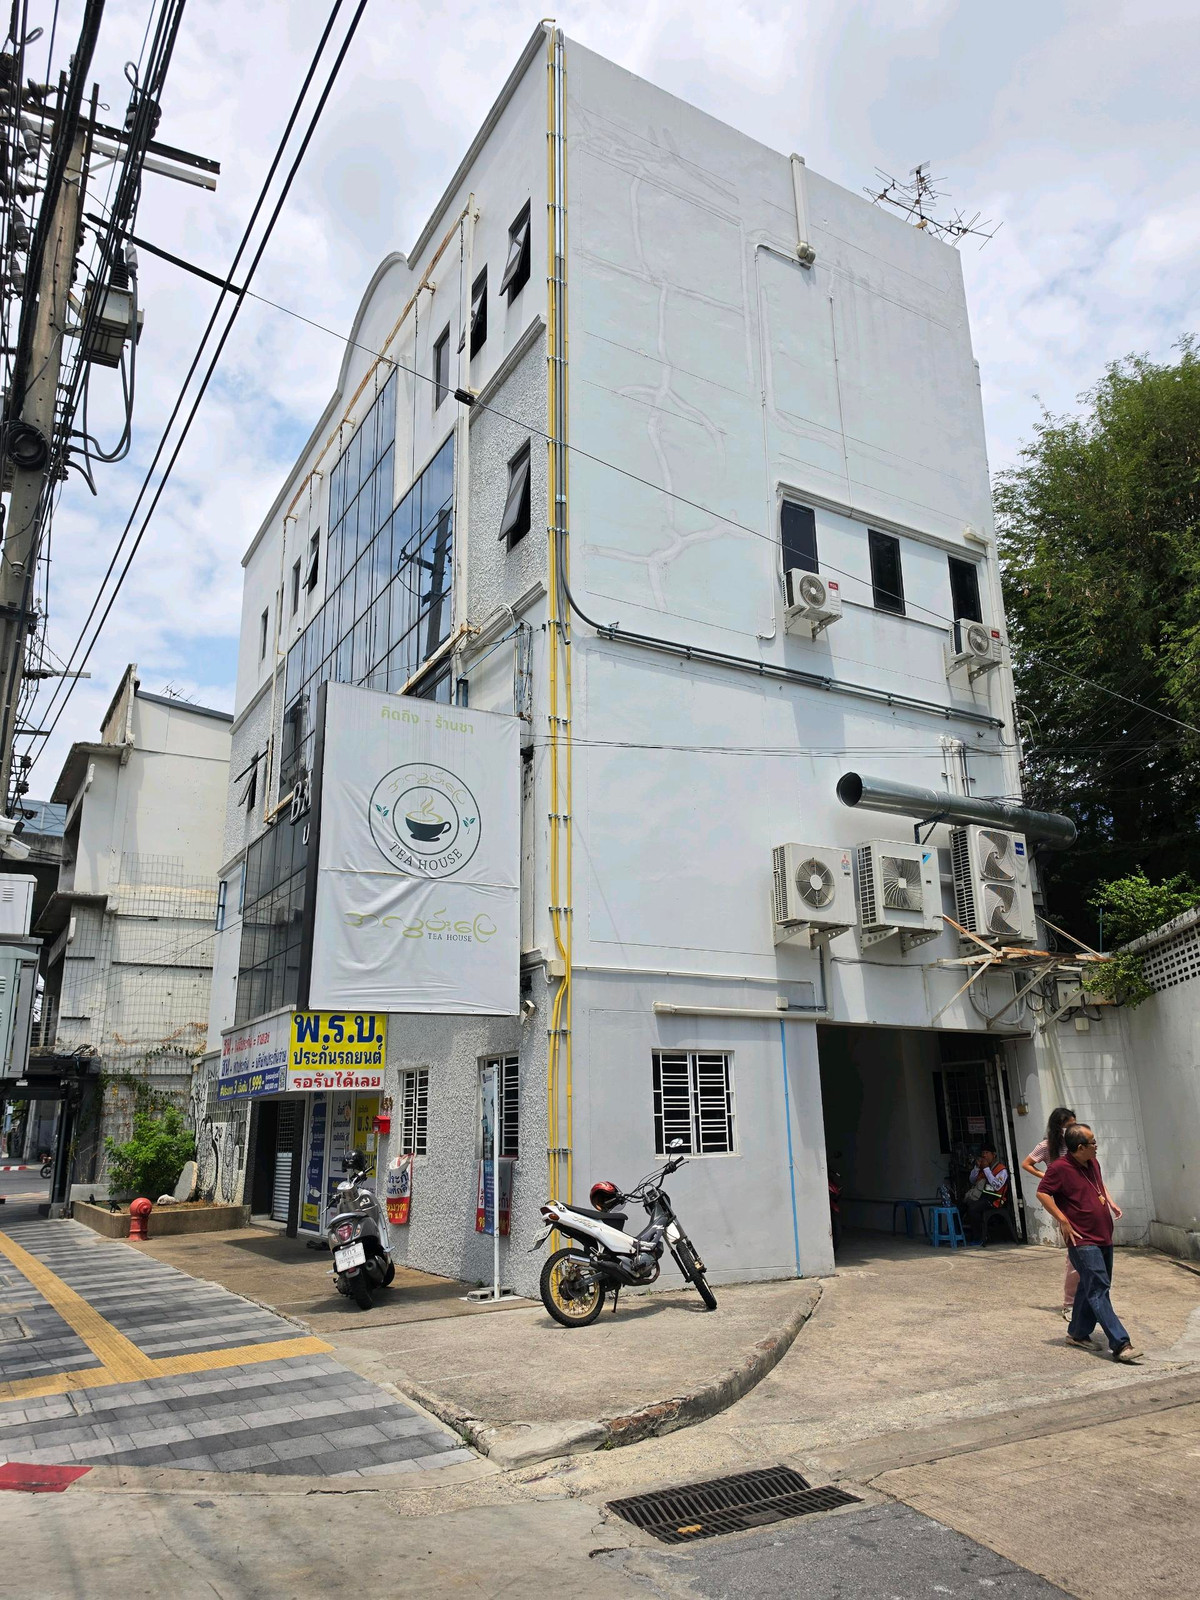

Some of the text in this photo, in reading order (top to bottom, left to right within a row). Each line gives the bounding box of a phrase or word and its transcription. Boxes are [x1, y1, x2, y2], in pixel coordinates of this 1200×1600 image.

[381, 705, 419, 724] คิดถึง
[435, 714, 474, 734] ร้านชา
[389, 841, 463, 871] TEA HOUSE
[427, 932, 473, 943] TEA HOUSE
[294, 1014, 384, 1043] พ.ร.บ.
[293, 1043, 384, 1065] ประกันรถยนต์
[293, 1071, 381, 1089] รอรับได้เลย
